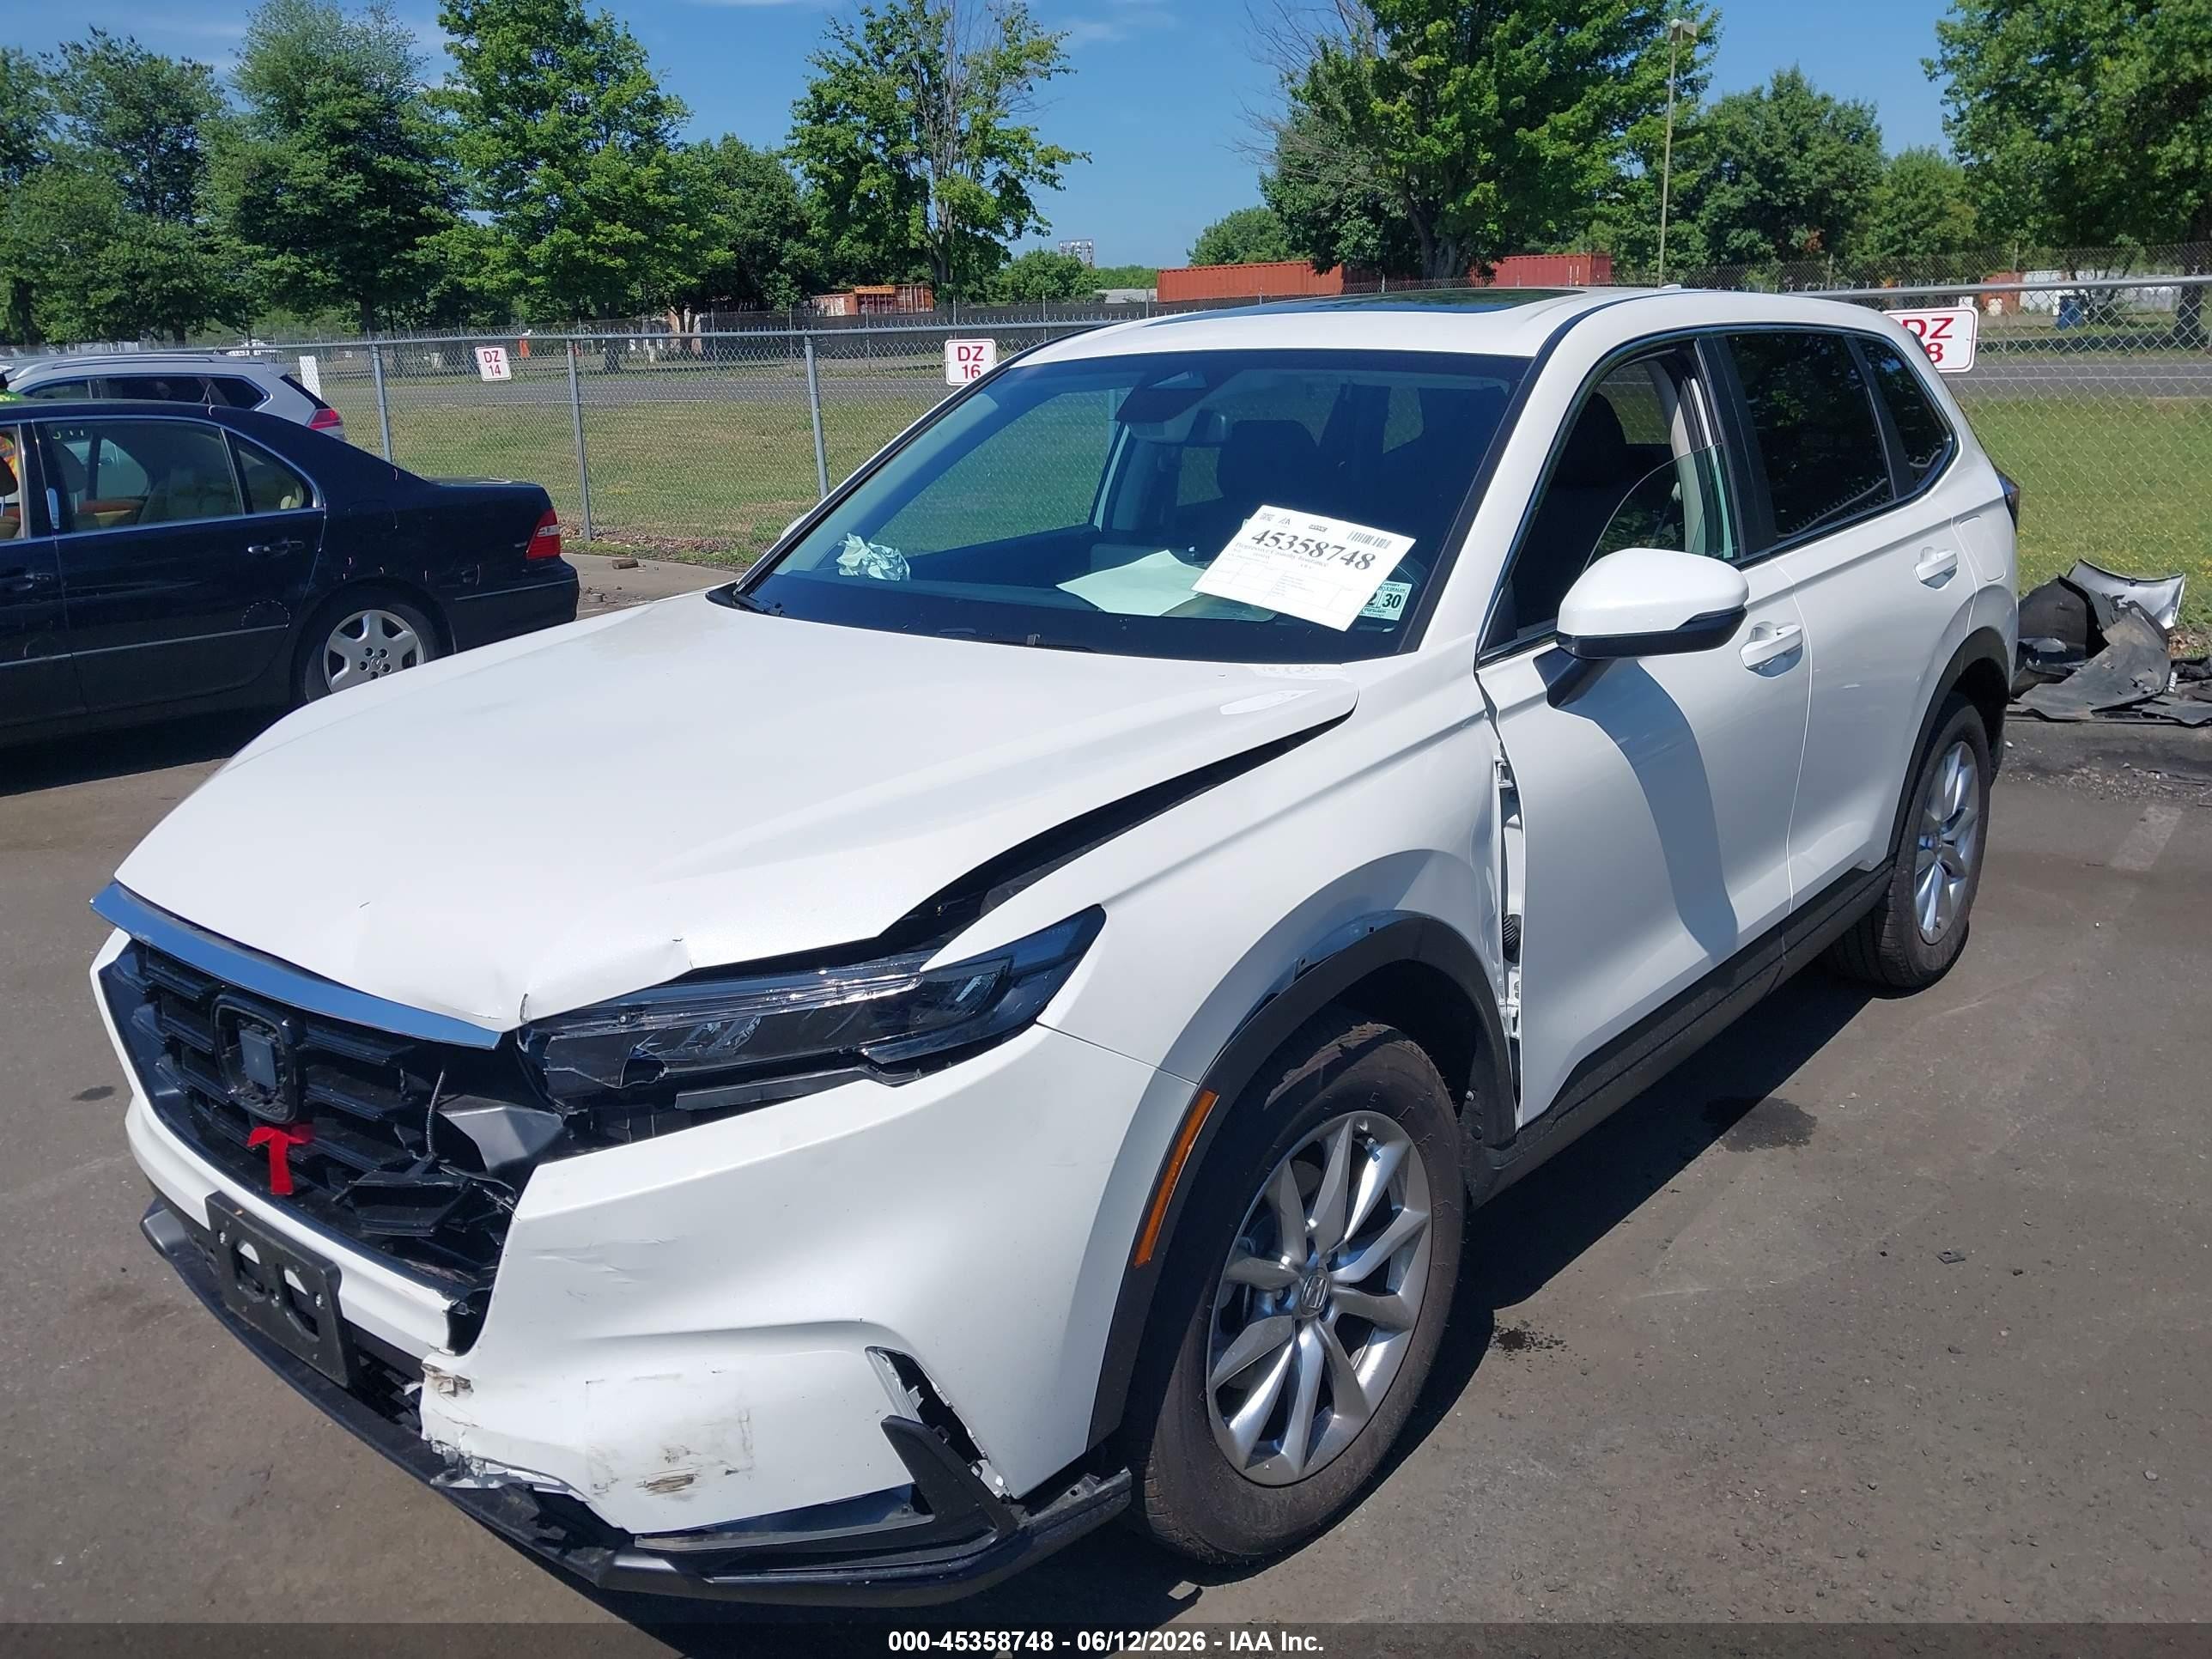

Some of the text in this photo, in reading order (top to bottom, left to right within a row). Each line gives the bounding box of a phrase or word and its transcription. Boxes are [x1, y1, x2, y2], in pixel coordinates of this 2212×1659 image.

[1902, 318, 1954, 338] DZ
[483, 350, 501, 363] DZ
[957, 346, 984, 362] DZ
[1925, 343, 1943, 363] 8
[489, 364, 501, 377] 14
[962, 364, 981, 379] 16
[1251, 529, 1376, 570] 45358748
[1382, 592, 1402, 609] 30
